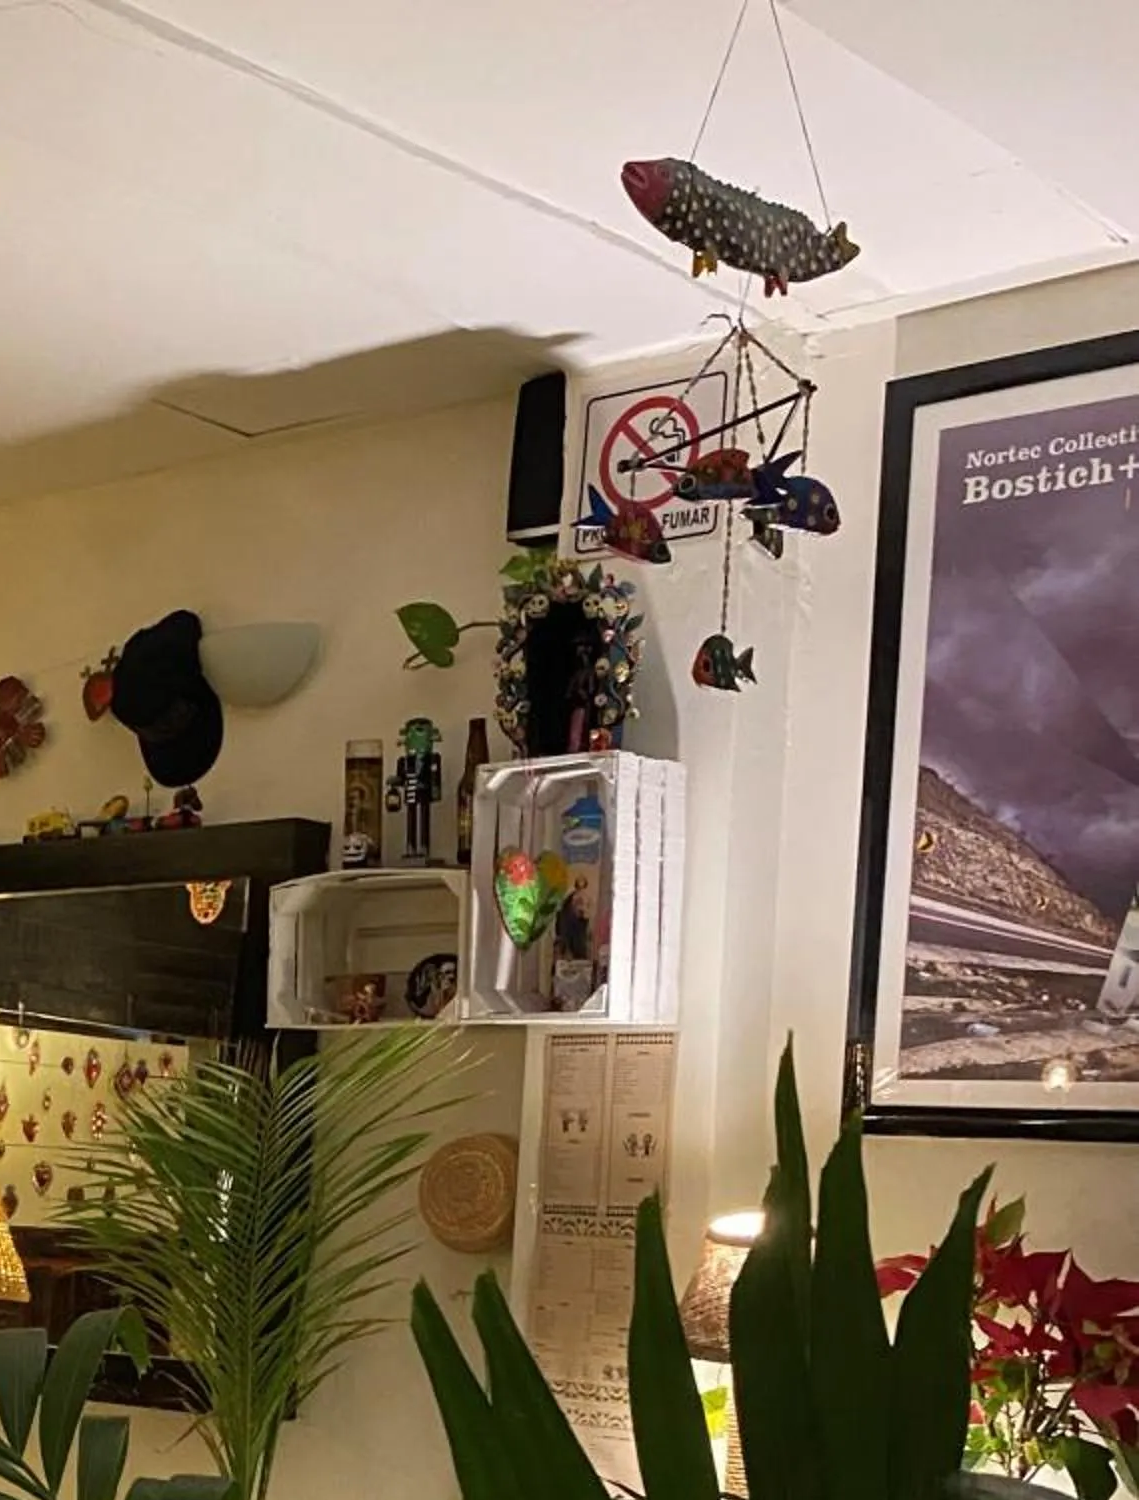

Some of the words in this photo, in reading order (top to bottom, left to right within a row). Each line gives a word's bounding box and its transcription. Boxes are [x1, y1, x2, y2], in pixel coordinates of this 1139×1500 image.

[965, 444, 1042, 469] Nortec
[1048, 424, 1139, 456] Collecti
[662, 508, 710, 530] FUMAR
